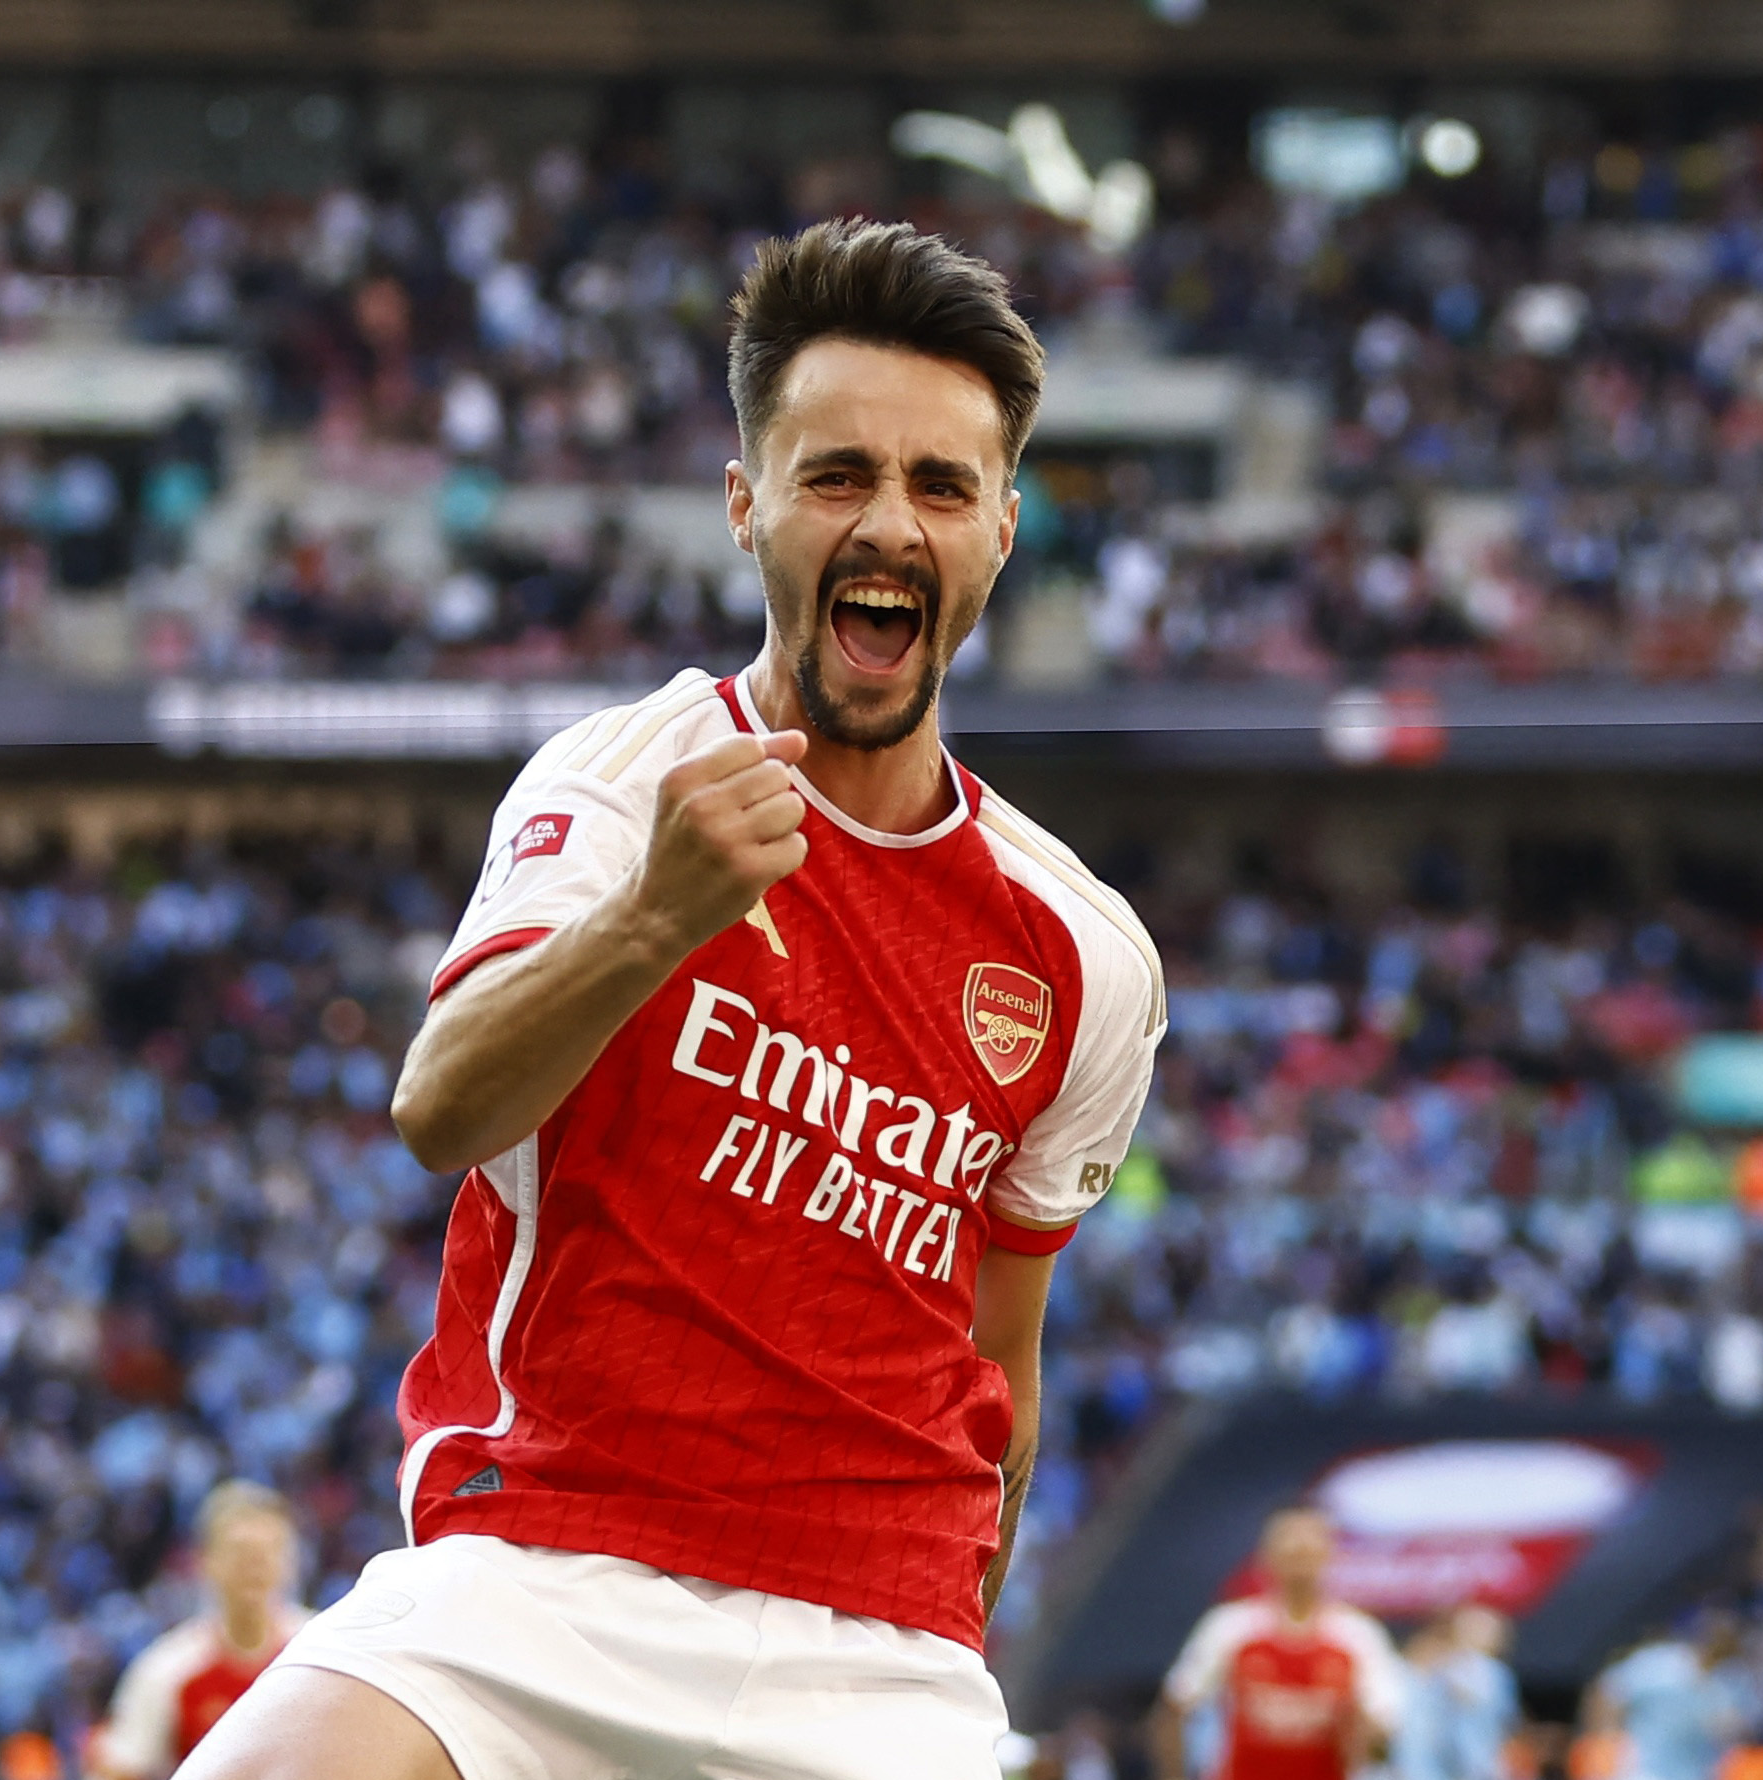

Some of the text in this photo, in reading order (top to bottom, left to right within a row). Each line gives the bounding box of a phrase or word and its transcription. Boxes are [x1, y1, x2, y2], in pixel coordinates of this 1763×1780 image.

[977, 982, 1039, 1016] Arsenal
[672, 977, 1015, 1203] Emirates
[699, 1114, 963, 1282] FLY BETTER
